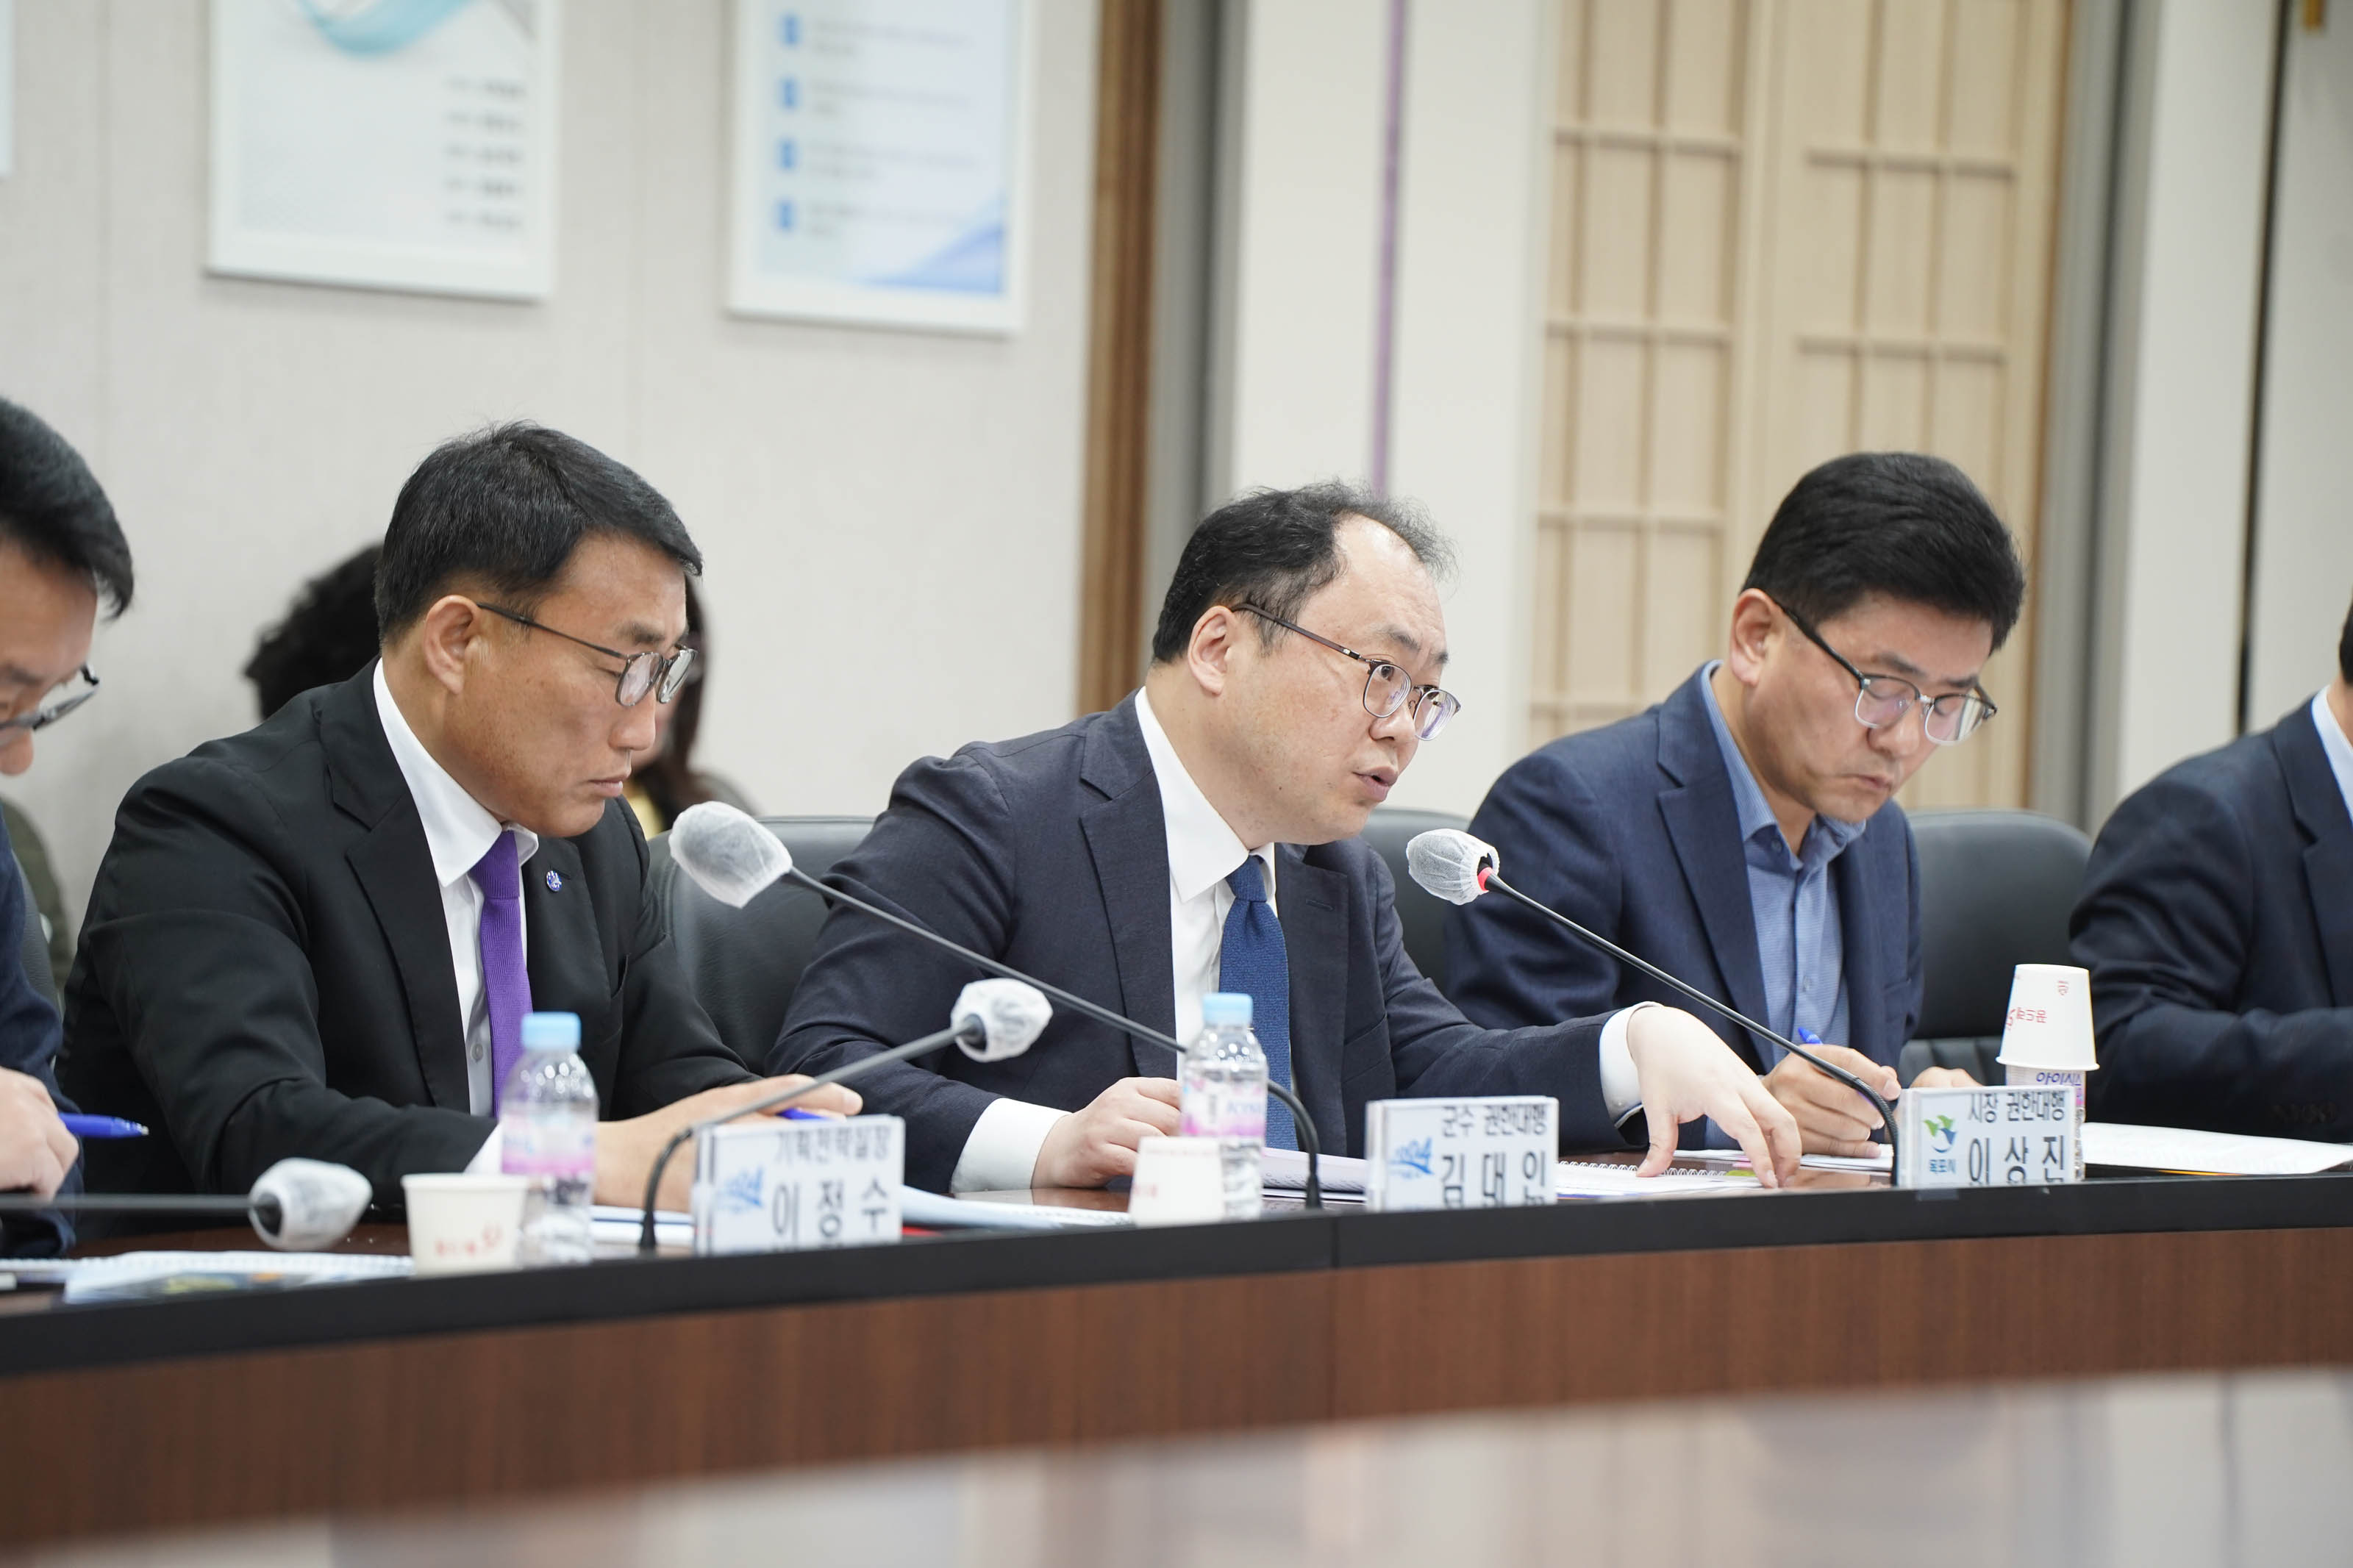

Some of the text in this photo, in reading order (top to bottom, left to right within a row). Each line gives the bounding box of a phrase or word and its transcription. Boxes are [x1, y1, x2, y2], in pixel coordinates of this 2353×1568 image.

[1442, 1105, 1546, 1138] 군수 권한대행
[1968, 1090, 2065, 1123] 시장 권한대행
[1441, 1150, 1546, 1206] 김대인
[1968, 1135, 2065, 1184] 이상진
[772, 1176, 888, 1242] 이정수
